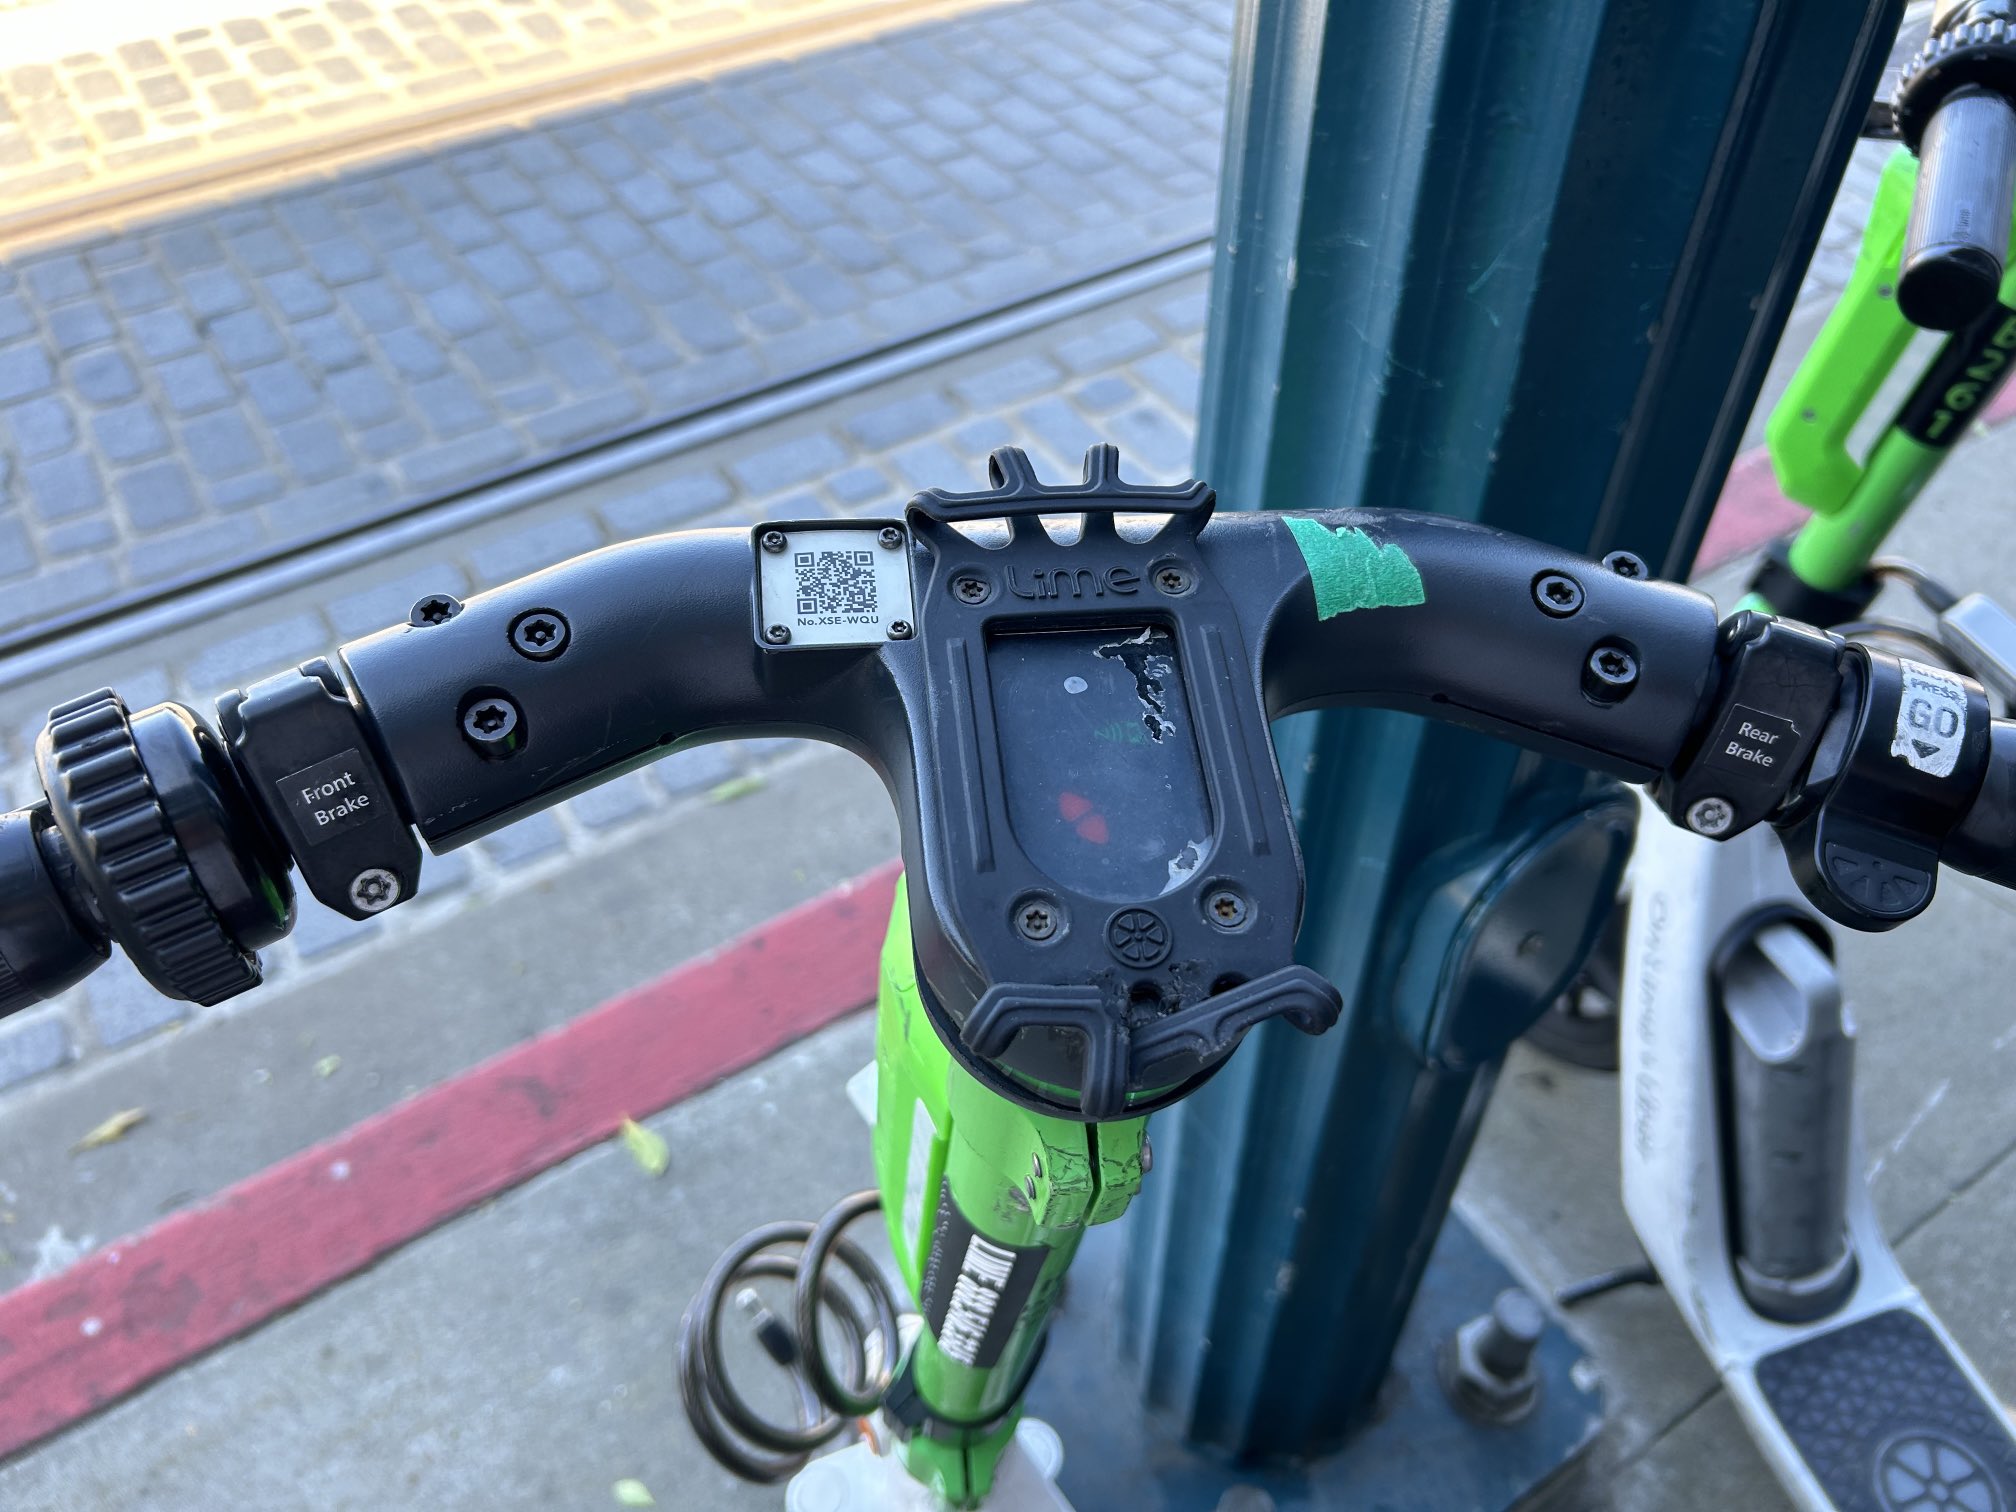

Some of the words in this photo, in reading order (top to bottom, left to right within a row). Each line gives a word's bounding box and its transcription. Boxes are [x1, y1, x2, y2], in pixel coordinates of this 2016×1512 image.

[1005, 565, 1140, 599] Lime
[1738, 722, 1779, 744] Rear
[1908, 698, 1959, 738] GO
[1725, 741, 1774, 767] Brake
[301, 771, 356, 805] Front
[314, 794, 370, 826] Brake
